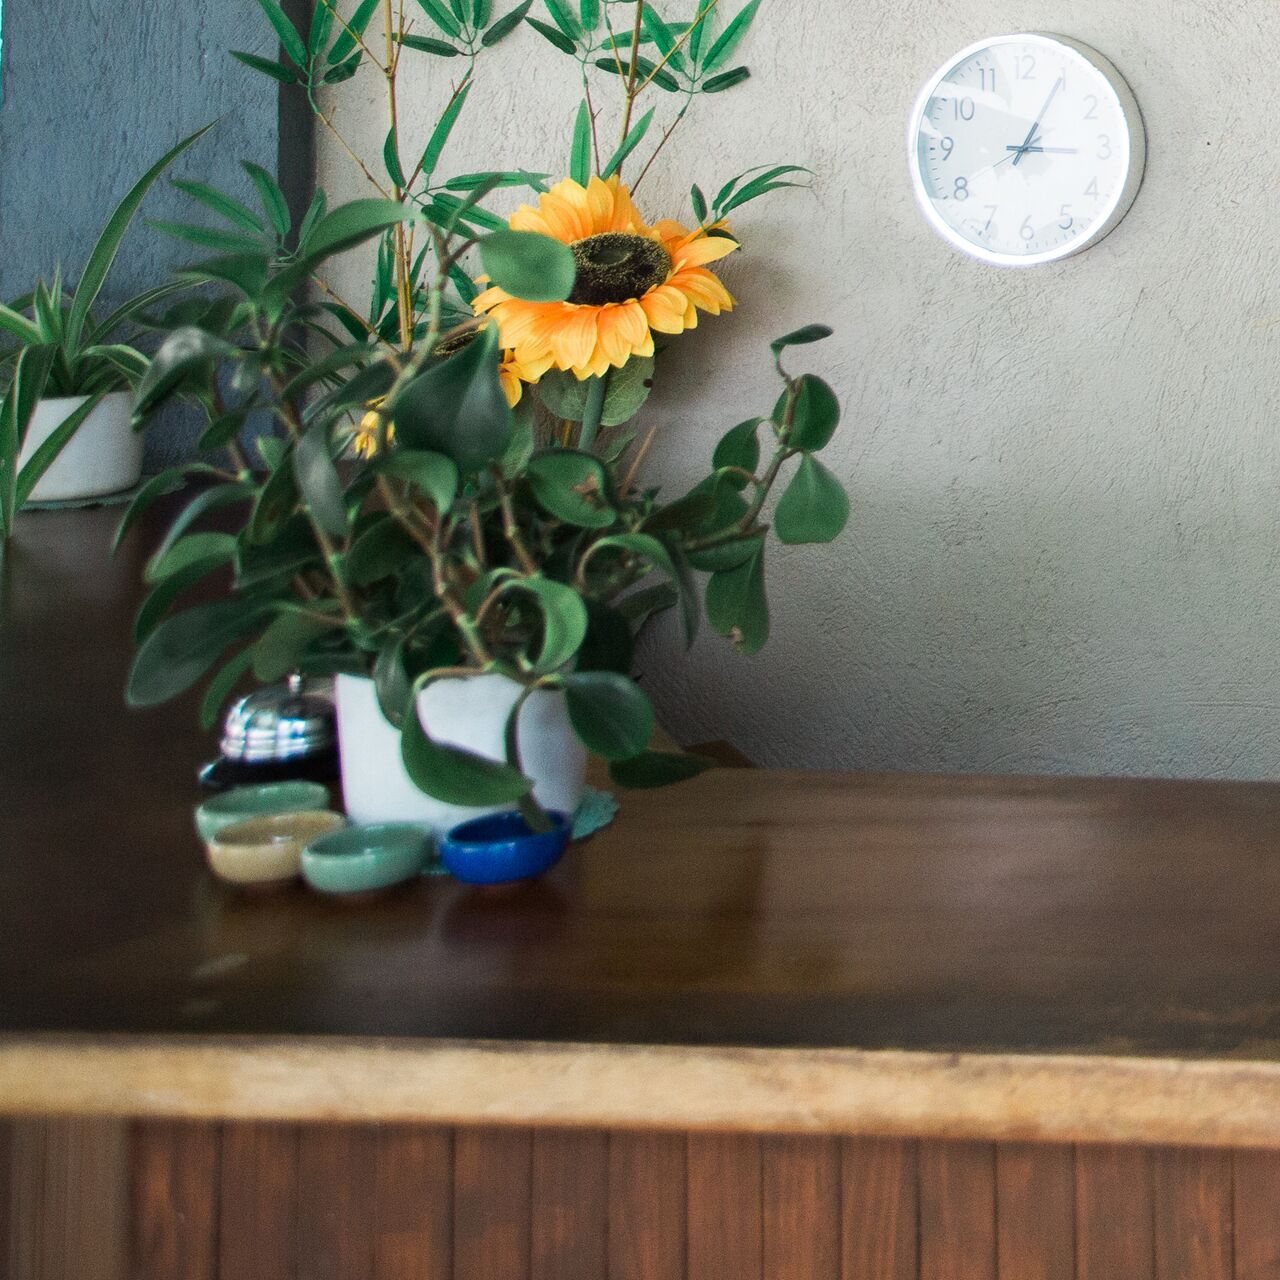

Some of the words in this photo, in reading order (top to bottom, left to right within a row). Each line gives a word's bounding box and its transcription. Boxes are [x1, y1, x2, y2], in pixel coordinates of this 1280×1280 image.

[1015, 55, 1036, 79] 12
[979, 68, 995, 92] 11
[952, 97, 975, 120] 10
[1084, 95, 1098, 120] 2
[940, 137, 954, 161] 9
[1097, 135, 1111, 160] 3
[954, 177, 968, 201] 8
[1084, 176, 1099, 200] 4
[984, 205, 997, 230] 7
[1020, 215, 1034, 240] 6
[1059, 204, 1073, 229] 5
